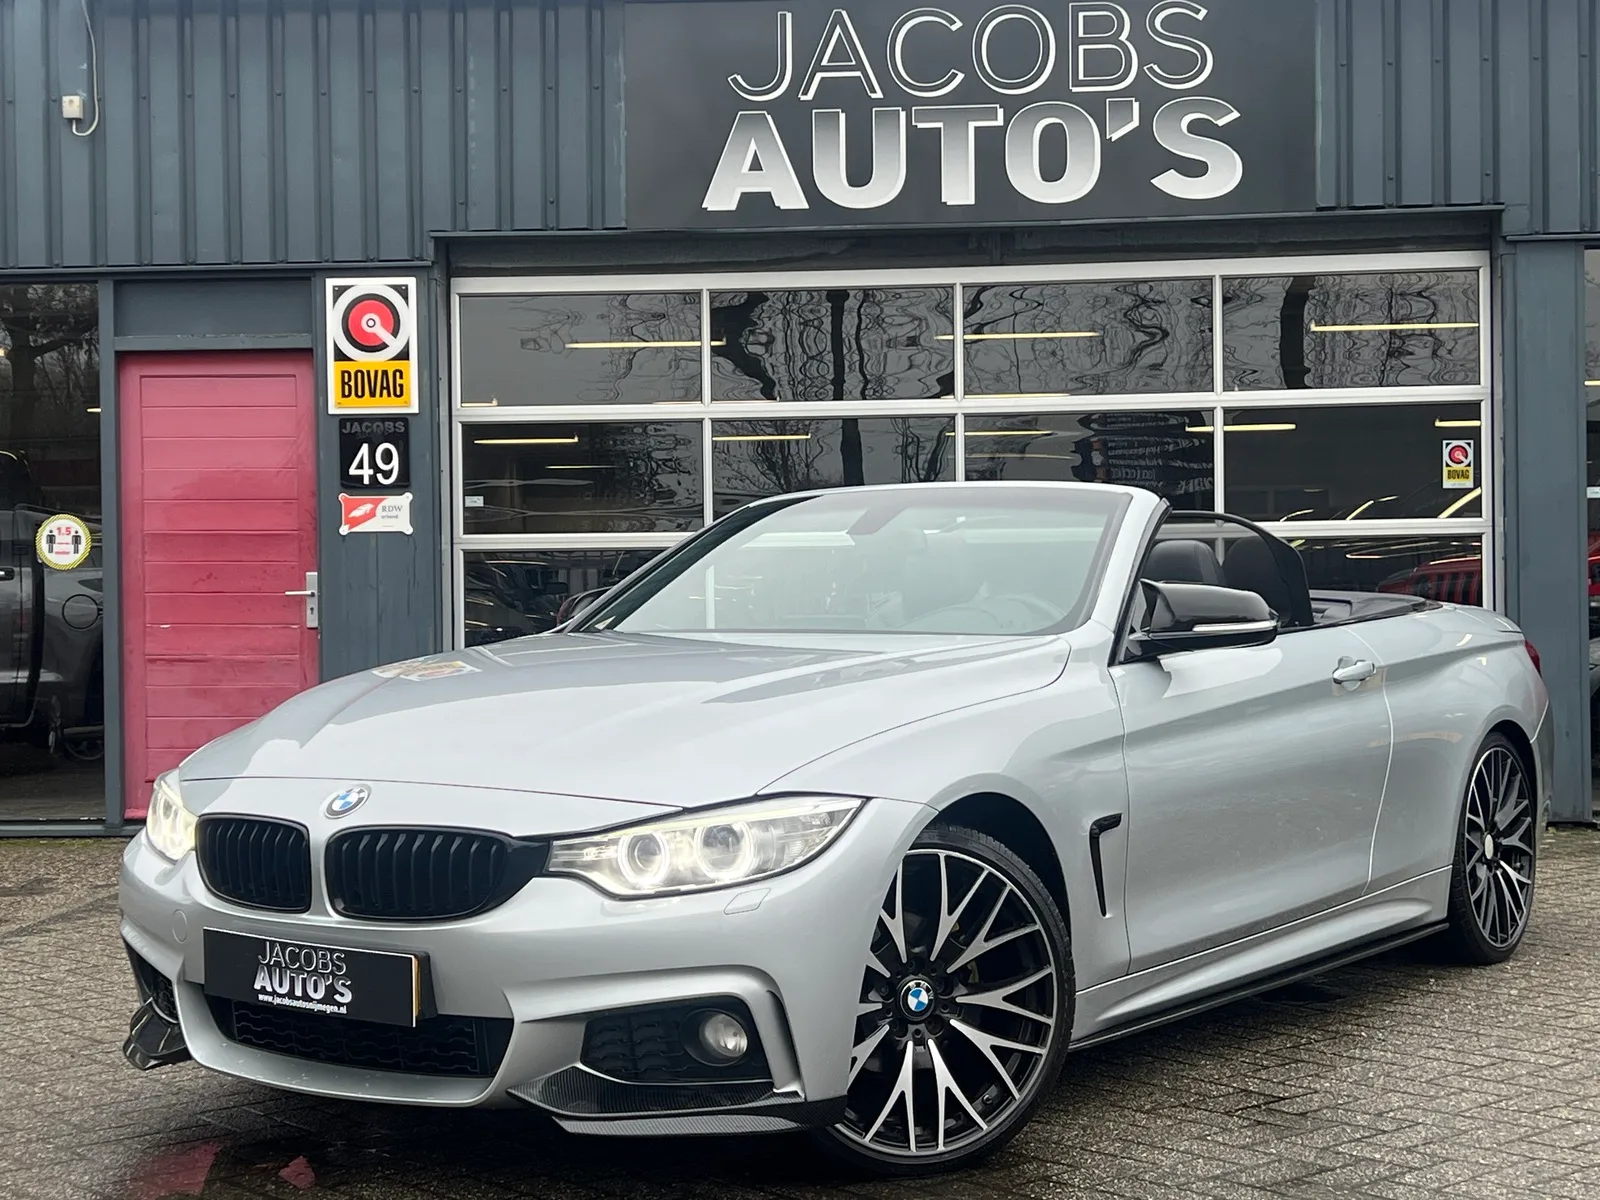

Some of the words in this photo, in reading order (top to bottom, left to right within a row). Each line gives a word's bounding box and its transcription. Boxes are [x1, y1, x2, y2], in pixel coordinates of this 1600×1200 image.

[727, 0, 1214, 102] JACOBS
[702, 97, 1243, 211] AUTO'S
[340, 368, 404, 398] BOVAG
[342, 421, 405, 434] JACOBS
[348, 442, 399, 485] 49
[381, 505, 403, 513] RDW
[258, 941, 346, 975] JACOBS
[253, 964, 353, 1003] AUTO'S
